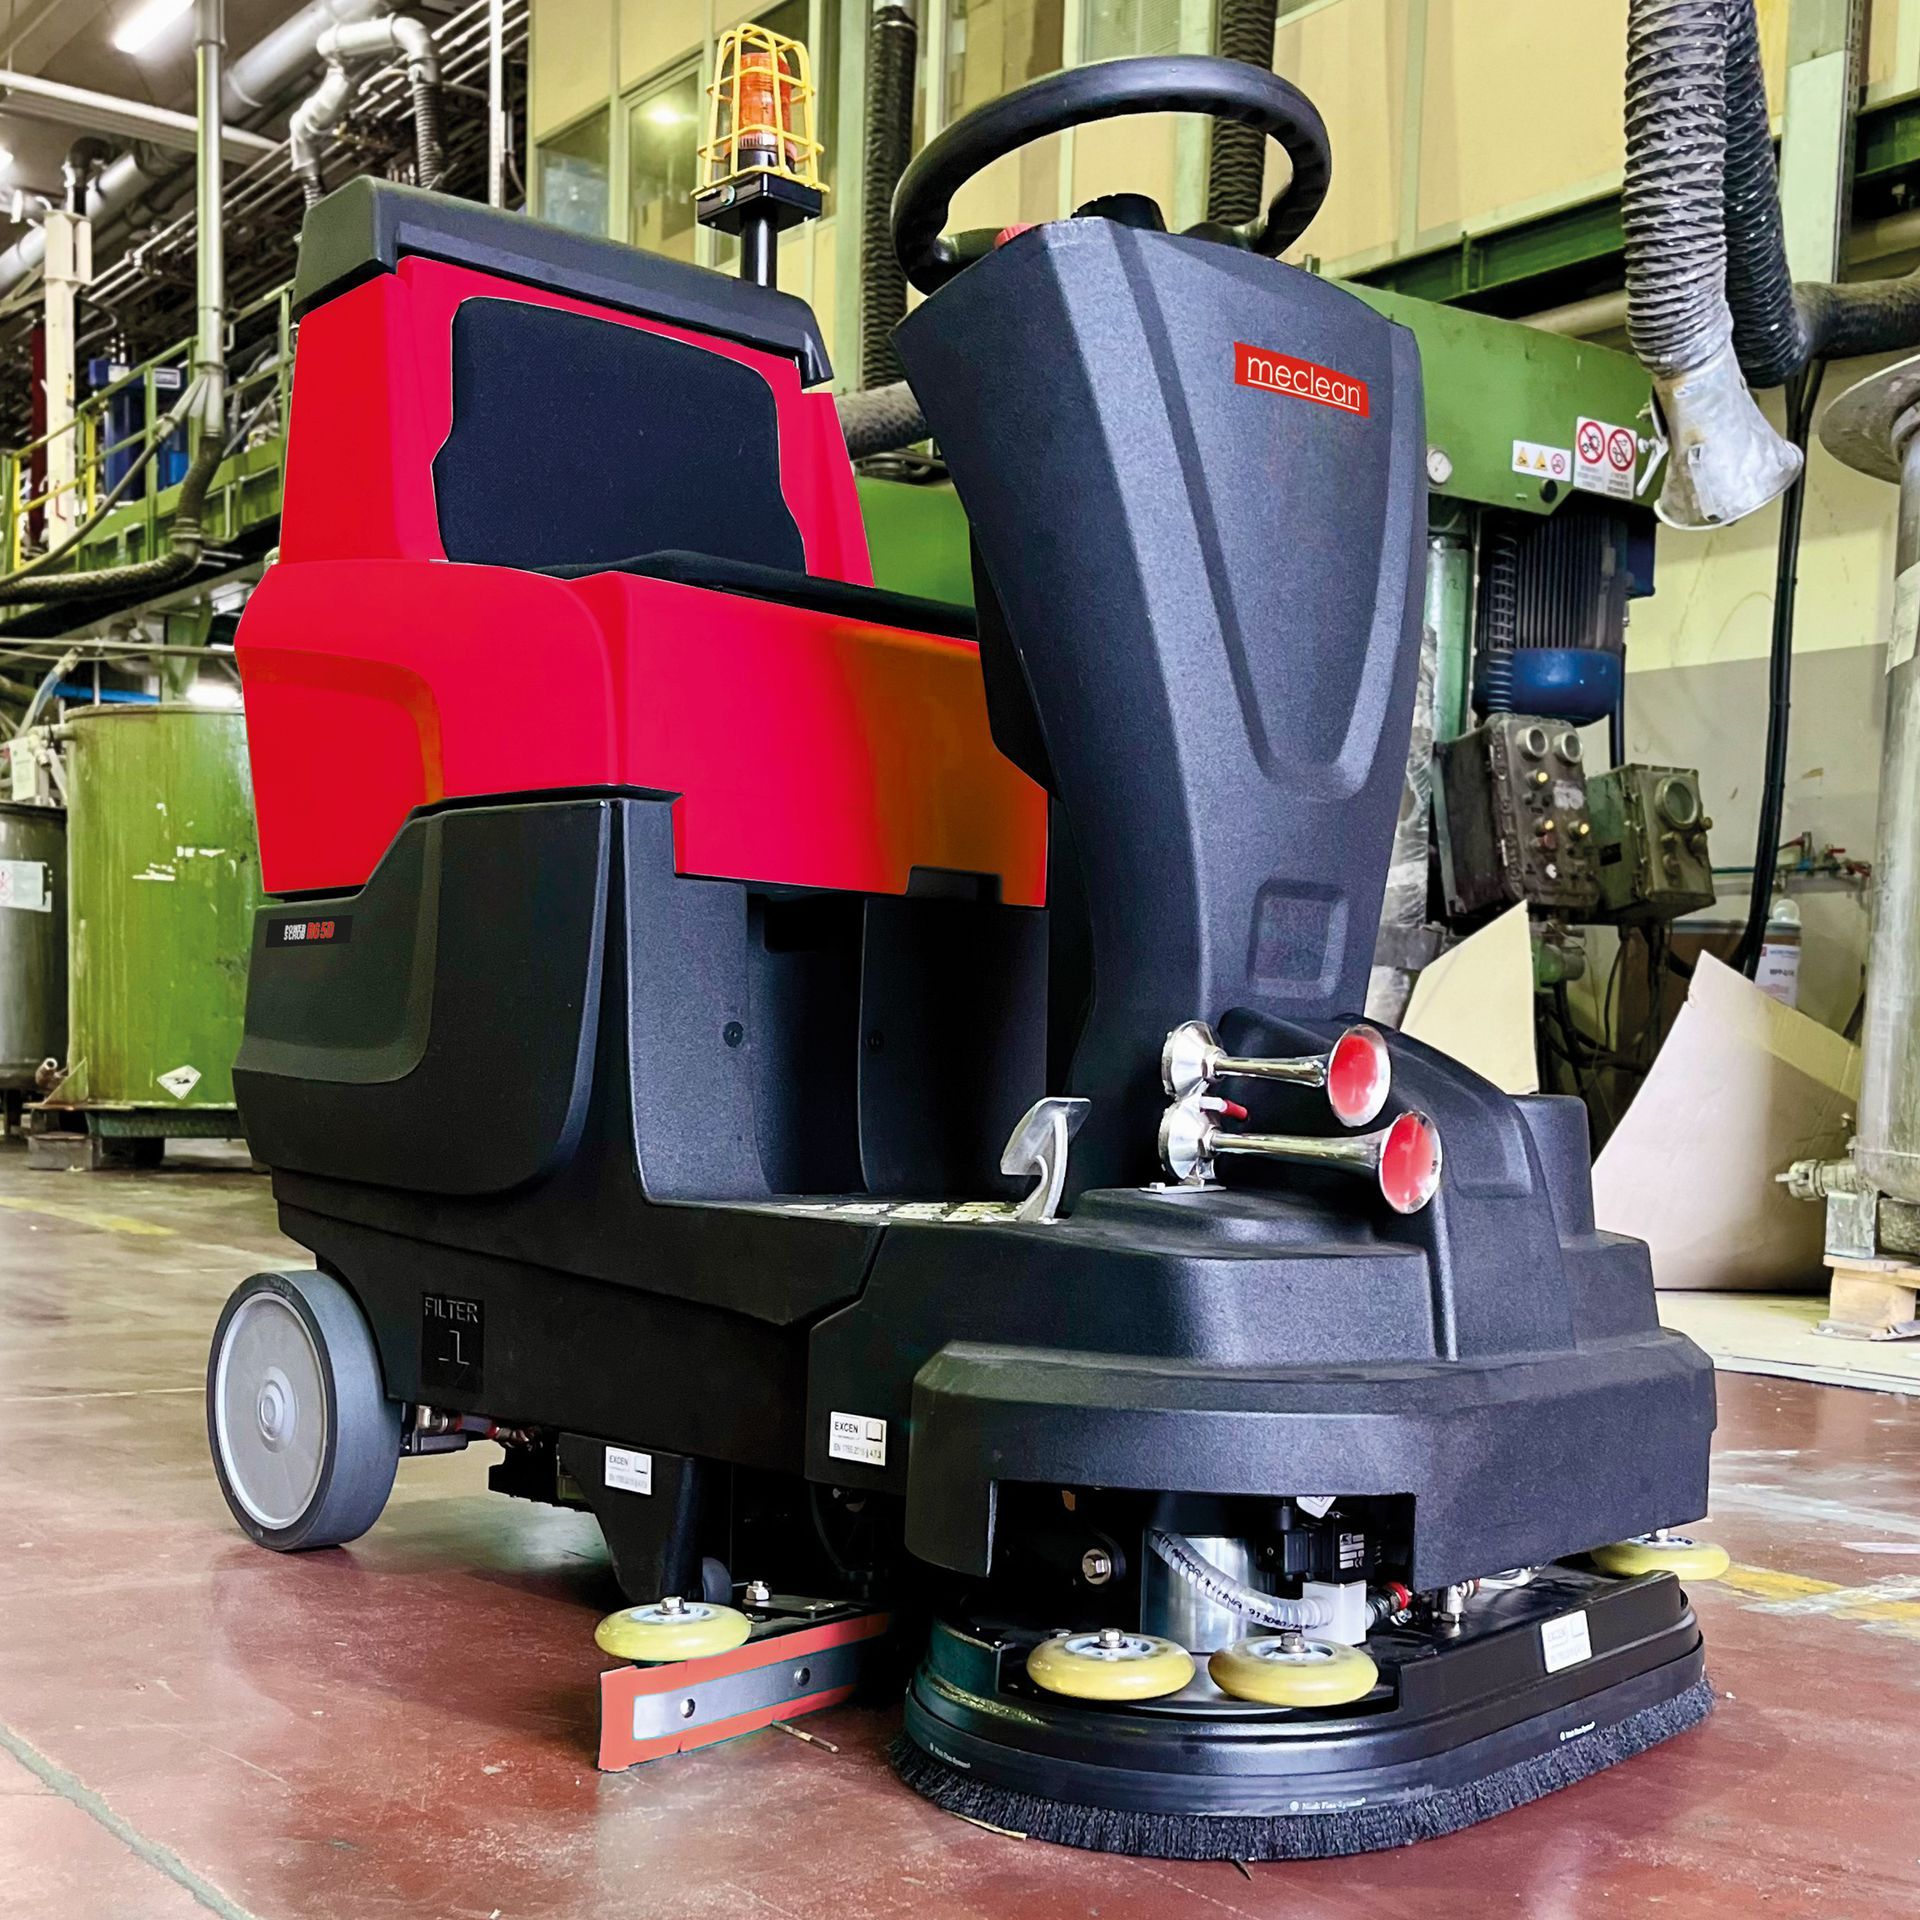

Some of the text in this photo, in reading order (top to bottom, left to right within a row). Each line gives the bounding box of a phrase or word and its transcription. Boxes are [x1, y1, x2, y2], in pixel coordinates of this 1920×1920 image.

[1247, 356, 1360, 409] meclean
[425, 1296, 478, 1323] FILTER
[834, 1421, 859, 1434] EXCEN
